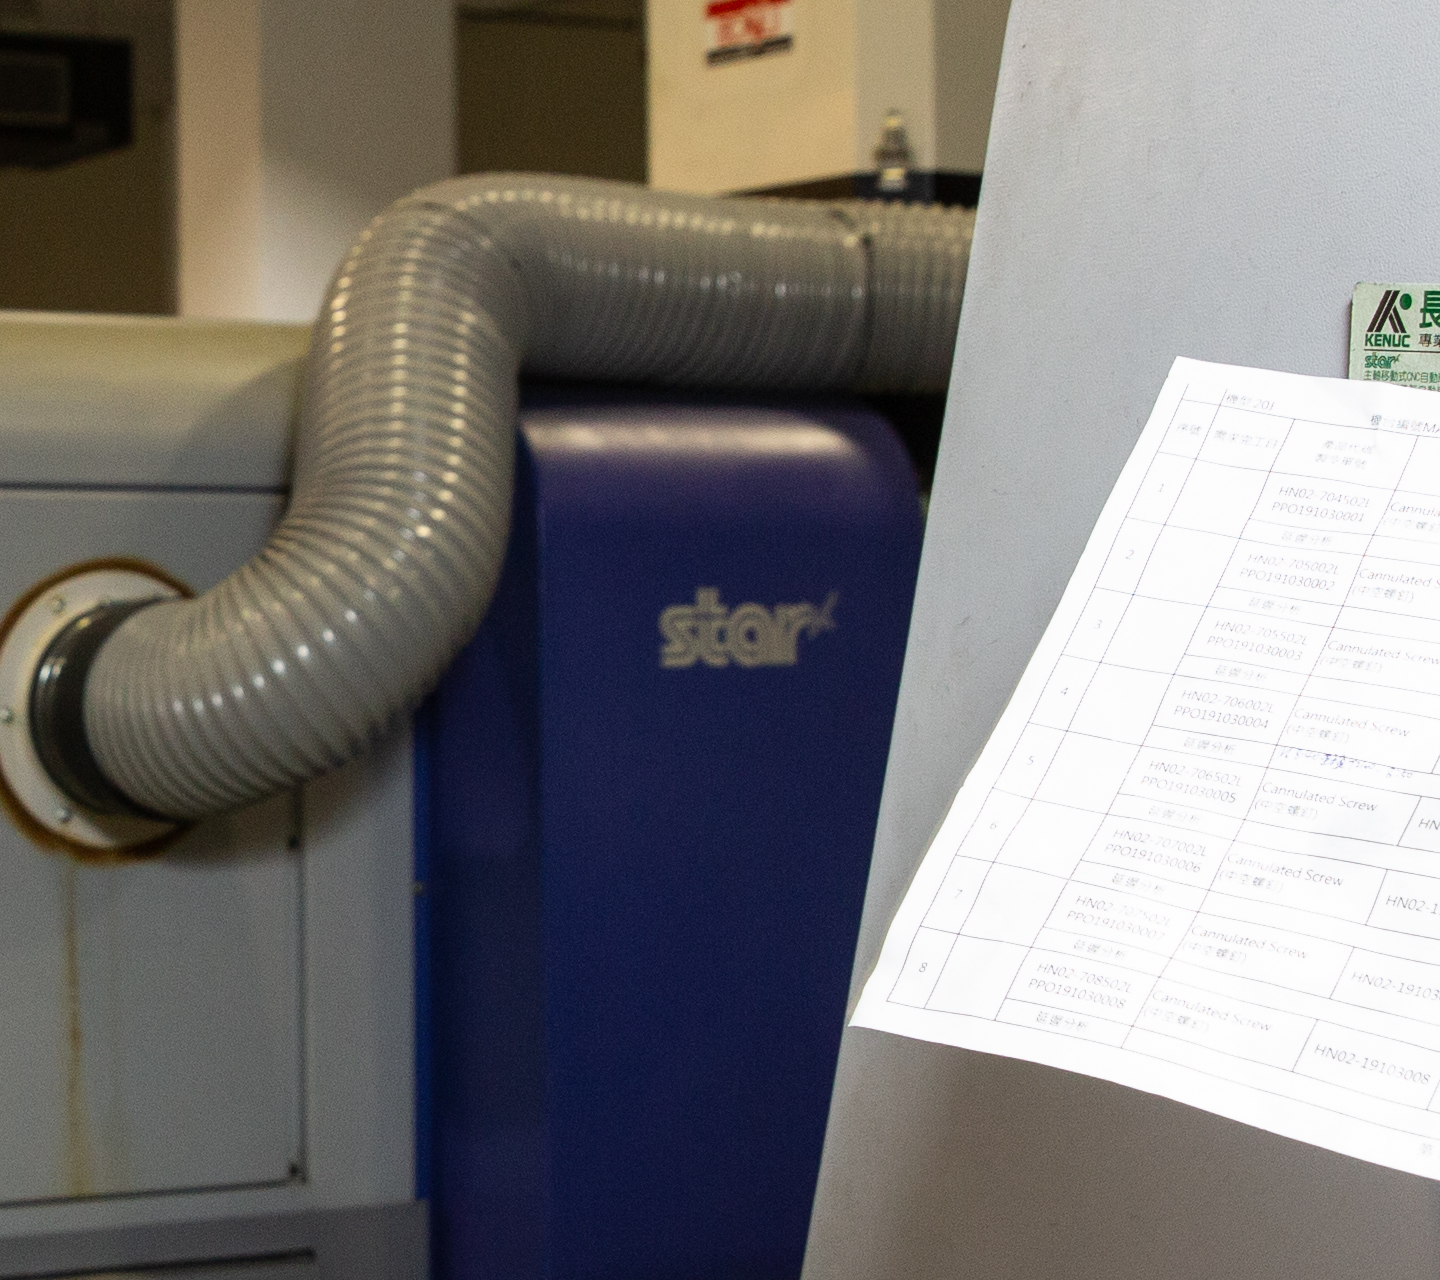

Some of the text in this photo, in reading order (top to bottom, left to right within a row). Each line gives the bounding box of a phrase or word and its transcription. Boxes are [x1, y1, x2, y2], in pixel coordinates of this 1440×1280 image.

[1365, 333, 1410, 348] KENUC
[1364, 353, 1400, 370] star
[1358, 567, 1431, 589] Cannulated
[658, 585, 839, 669] star
[1326, 639, 1401, 660] Cannulated
[1293, 707, 1412, 738] Cannulated Screw
[1261, 781, 1378, 812] Cannulated Screw
[1226, 852, 1345, 887] Cannulated Screw
[1314, 1042, 1431, 1086] HN02-19103008
